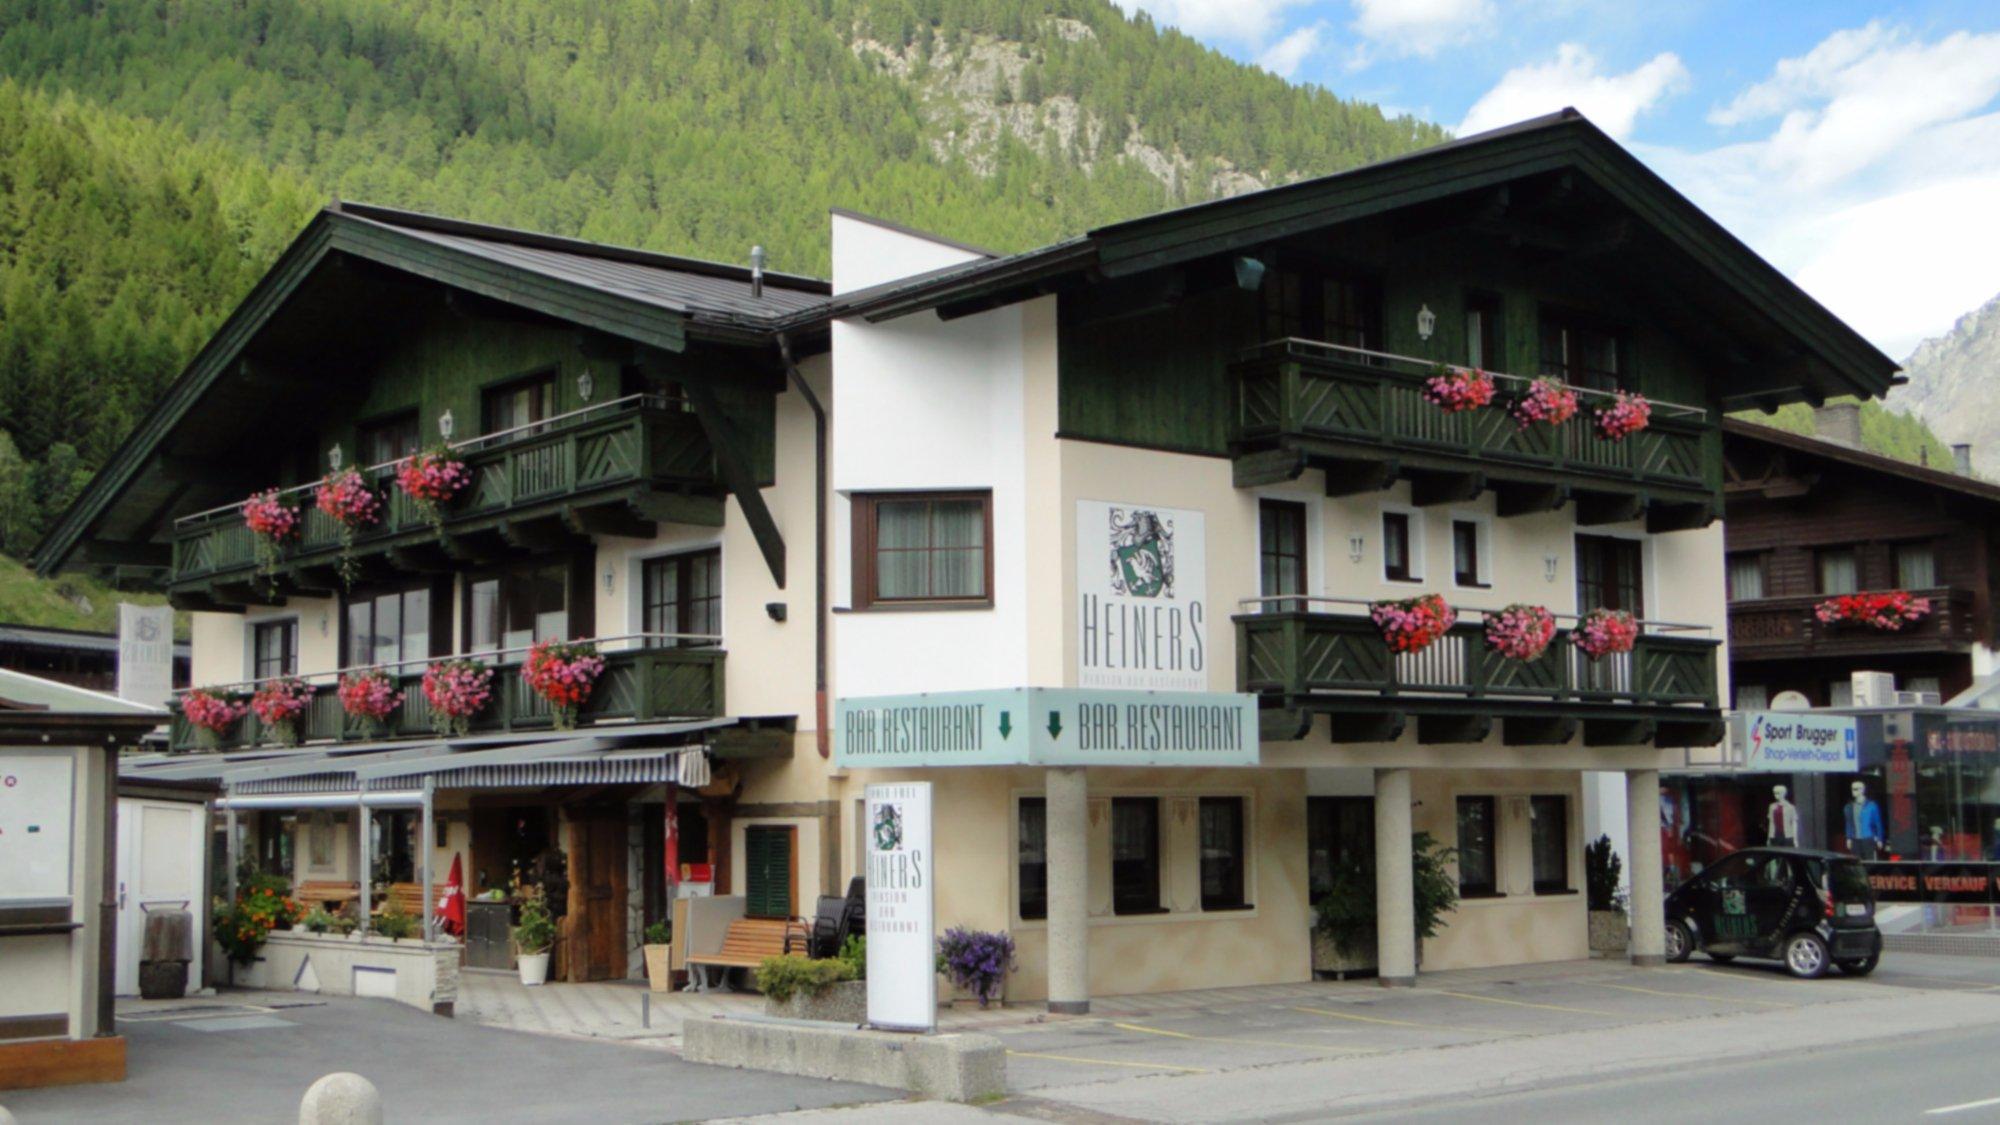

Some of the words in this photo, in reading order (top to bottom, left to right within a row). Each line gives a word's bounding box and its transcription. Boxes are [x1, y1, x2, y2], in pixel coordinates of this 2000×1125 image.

[1083, 594, 1203, 671] HEINERS
[845, 704, 984, 755] BAR.RESTAURANT
[1079, 703, 1243, 751] BAR.RESTAURANT
[1765, 722, 1792, 742] Sport
[1796, 724, 1837, 746] Brugger
[1869, 876, 1917, 891] ERVICE
[1924, 876, 1988, 892] VERKAUF
